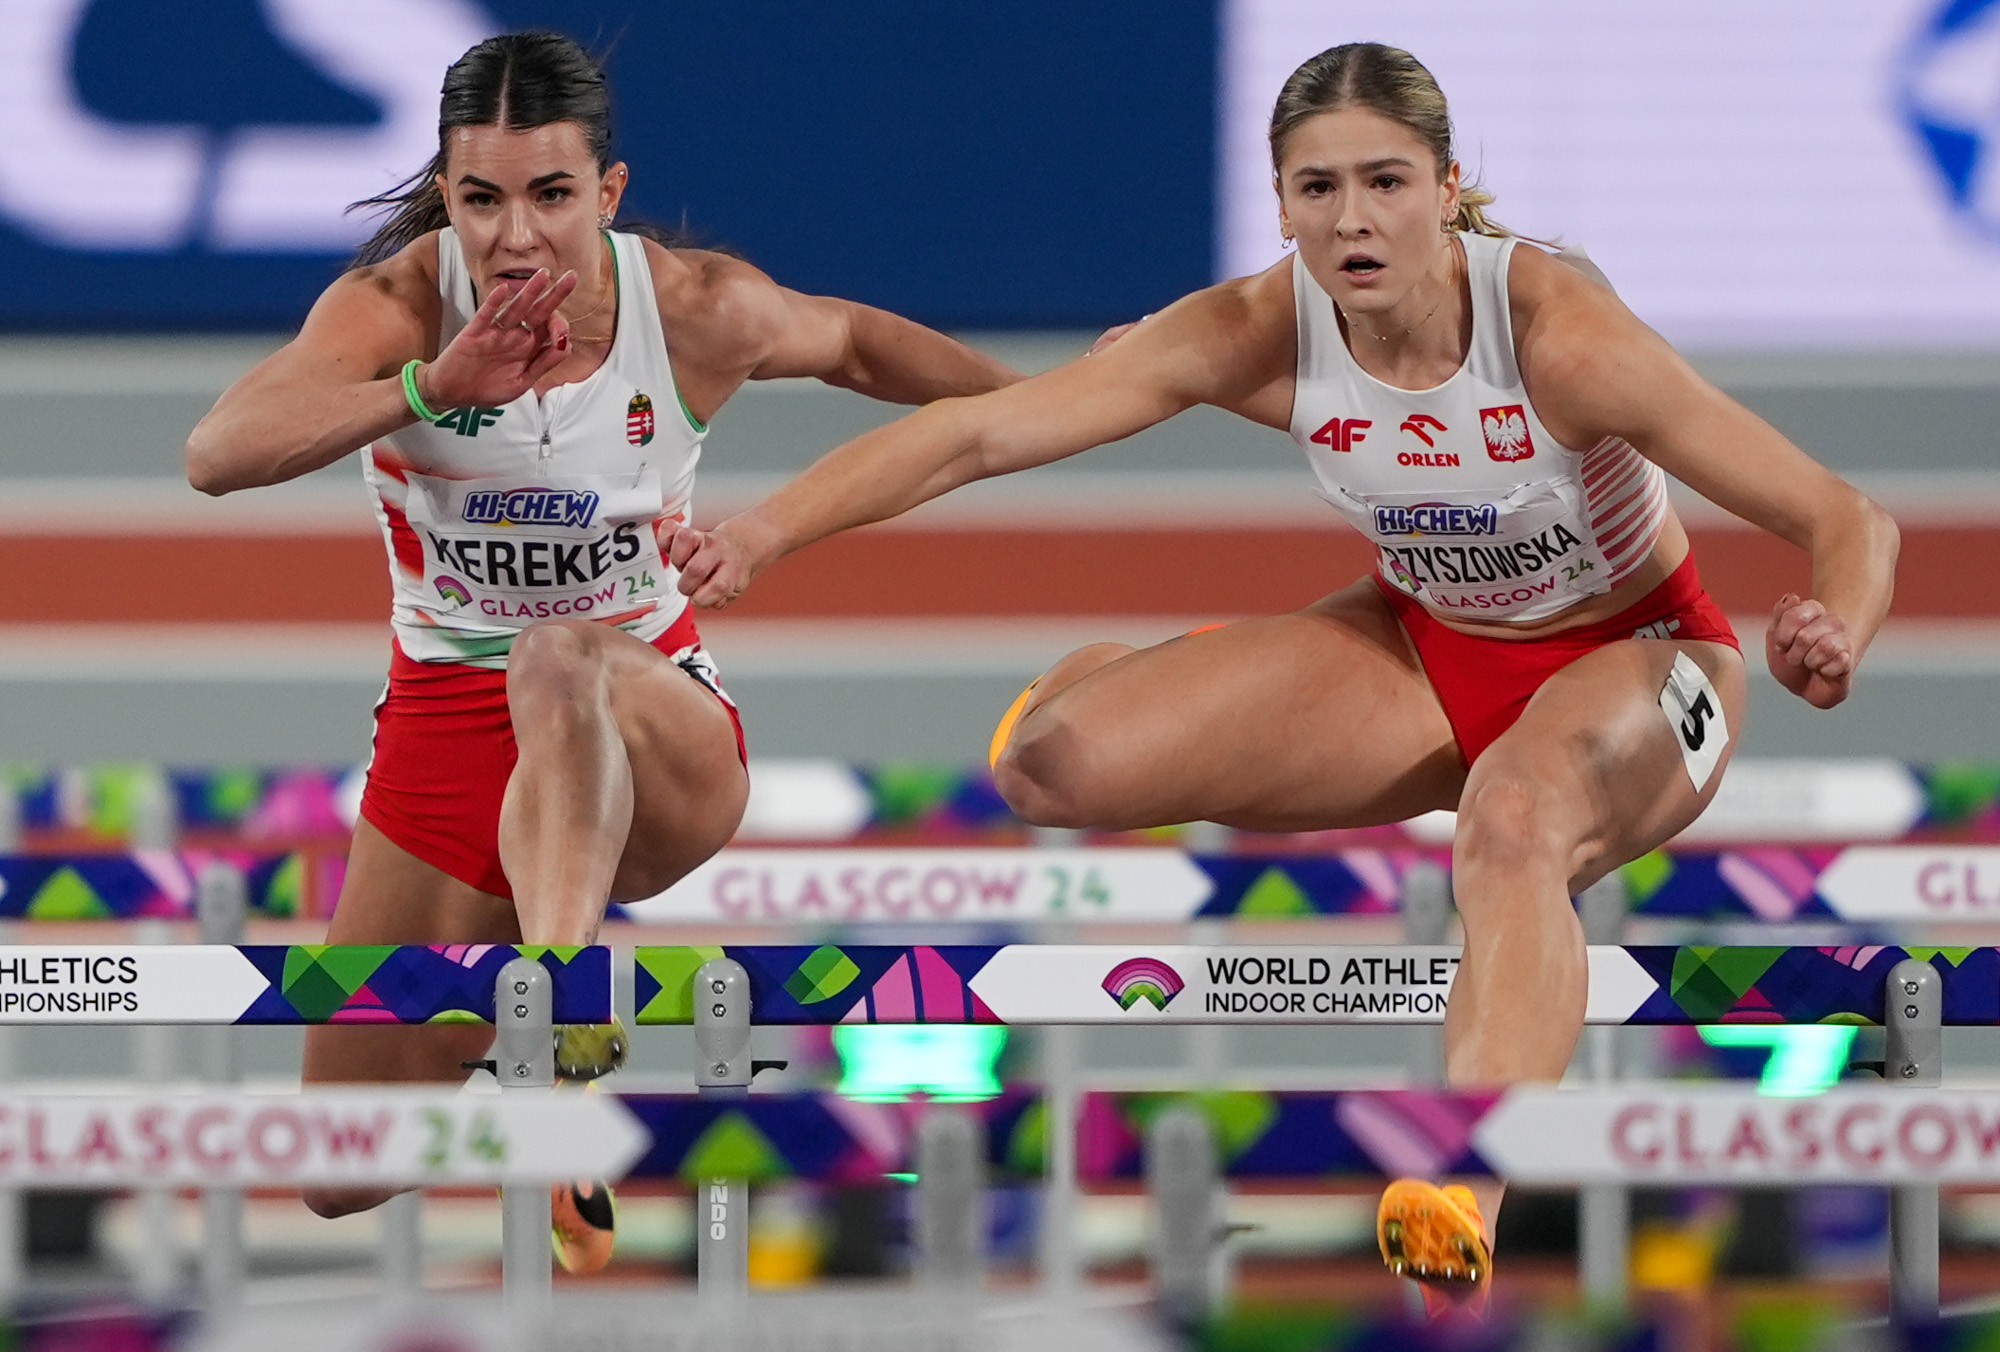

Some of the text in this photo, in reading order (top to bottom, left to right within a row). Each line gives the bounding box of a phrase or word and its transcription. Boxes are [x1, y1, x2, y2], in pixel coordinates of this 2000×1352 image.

[1310, 417, 1373, 453] 4F
[1397, 452, 1460, 467] ORLEN
[463, 489, 599, 529] HI-CHEW
[1374, 504, 1497, 535] HI-CHEW
[427, 521, 641, 587] KEREKES
[1561, 558, 1595, 581] 24
[480, 570, 656, 618] GLASGOW 24
[1681, 689, 1714, 751] 5
[712, 866, 1110, 917] GLASGOW 24
[1206, 957, 1331, 985] WORLD
[0, 991, 138, 1013] PIONSHIPS
[1205, 993, 1306, 1013] INDOOR
[420, 1105, 508, 1166] 24
